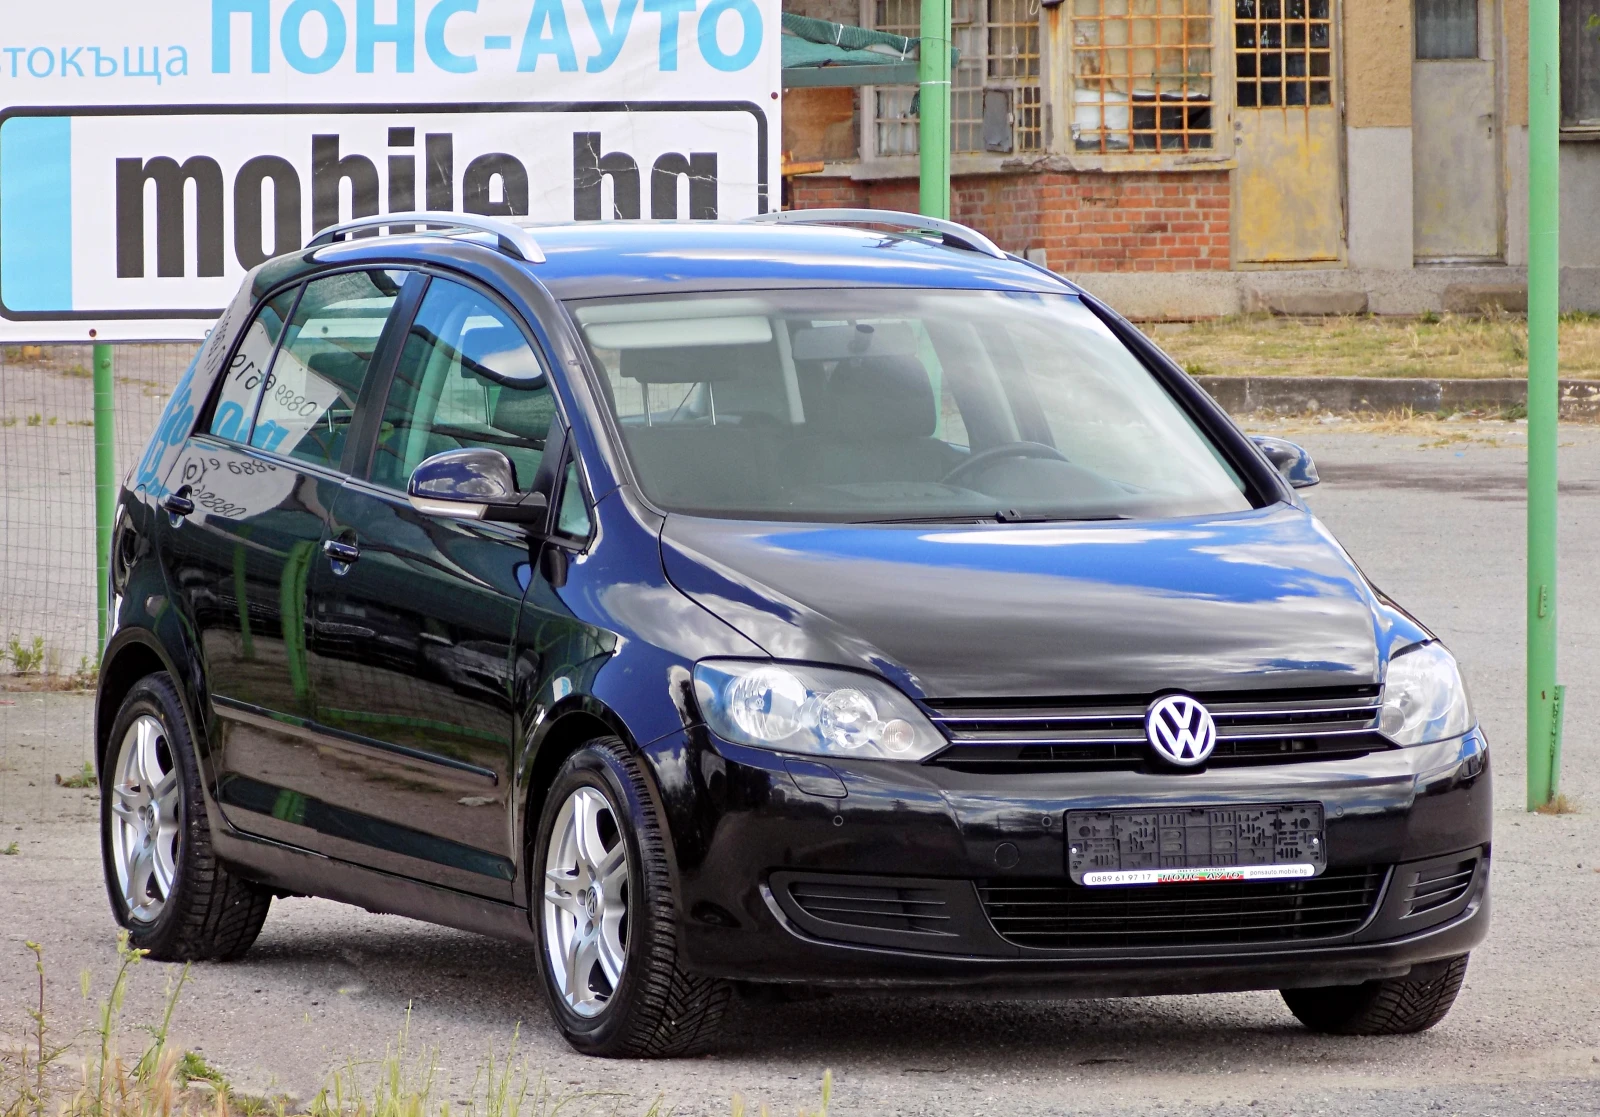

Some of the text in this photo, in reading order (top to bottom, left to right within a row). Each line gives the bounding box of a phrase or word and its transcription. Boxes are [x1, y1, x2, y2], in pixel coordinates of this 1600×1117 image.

[210, 0, 764, 75] ПОНС-АУТО
[1148, 694, 1217, 764] VW
[1091, 875, 1113, 883] 0889
[1128, 873, 1138, 881] 97
[1142, 873, 1152, 881] 17
